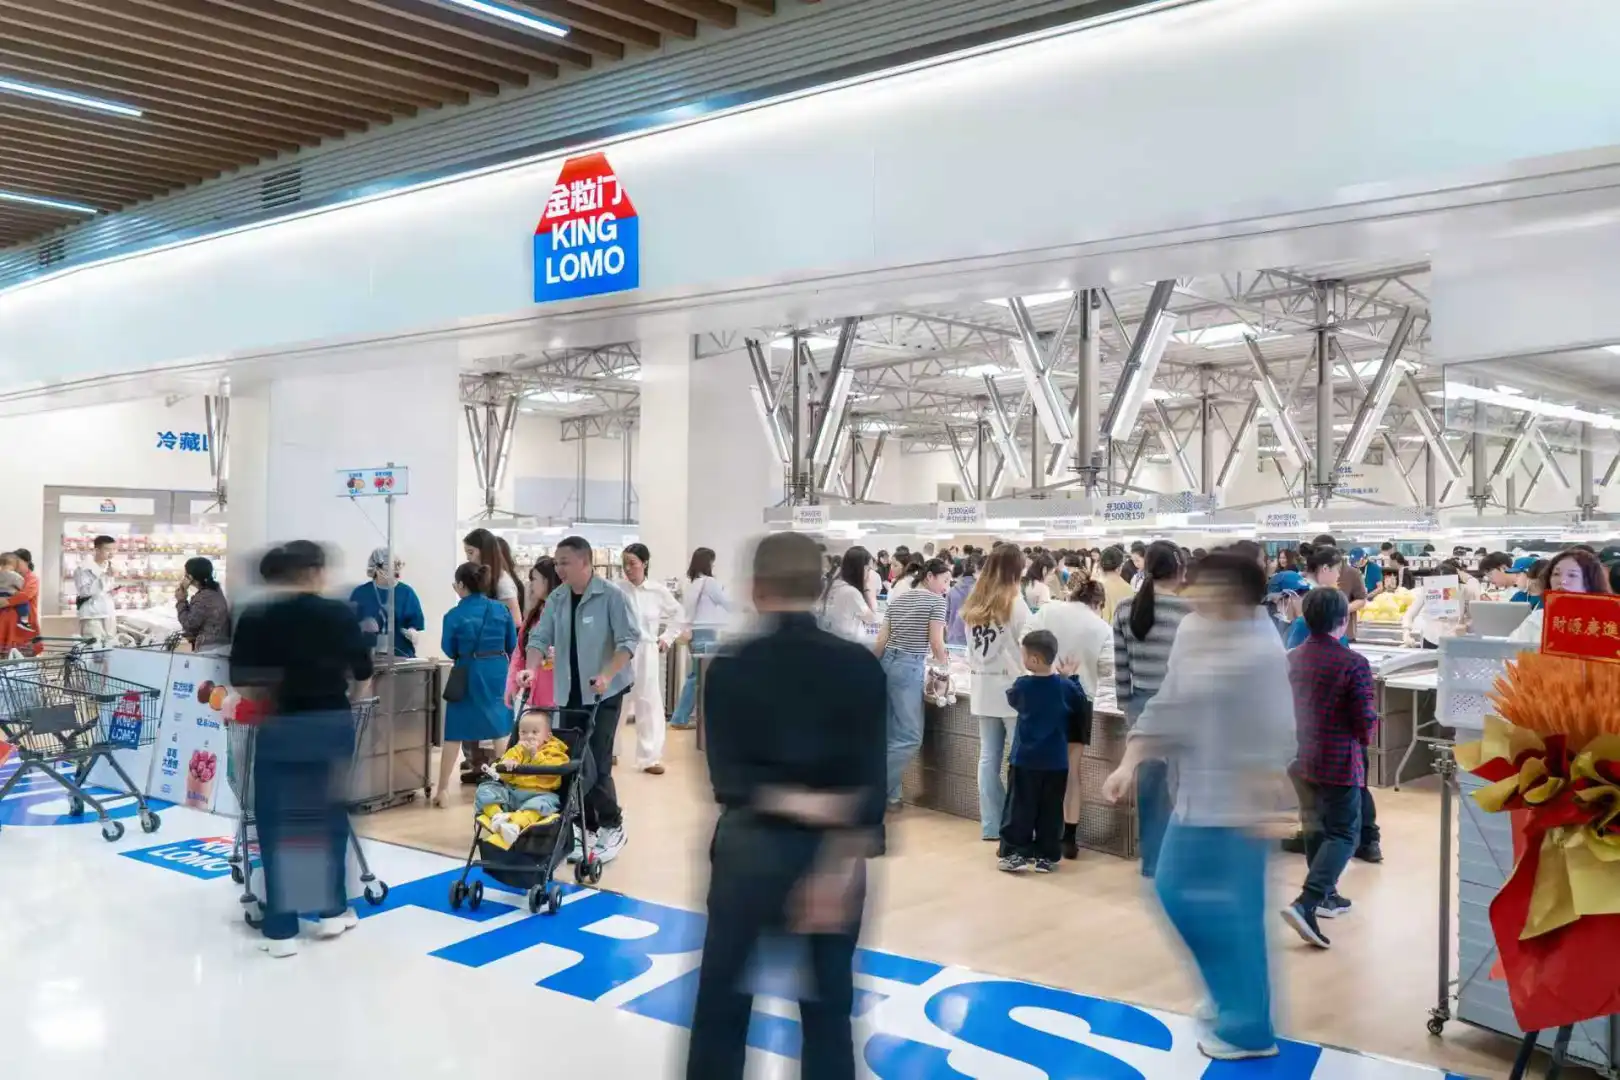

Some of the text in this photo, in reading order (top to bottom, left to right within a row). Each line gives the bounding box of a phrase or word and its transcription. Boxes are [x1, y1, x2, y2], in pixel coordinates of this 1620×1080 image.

[545, 175, 623, 219] 金粒门
[552, 212, 618, 251] KING
[546, 245, 625, 284] LOMO
